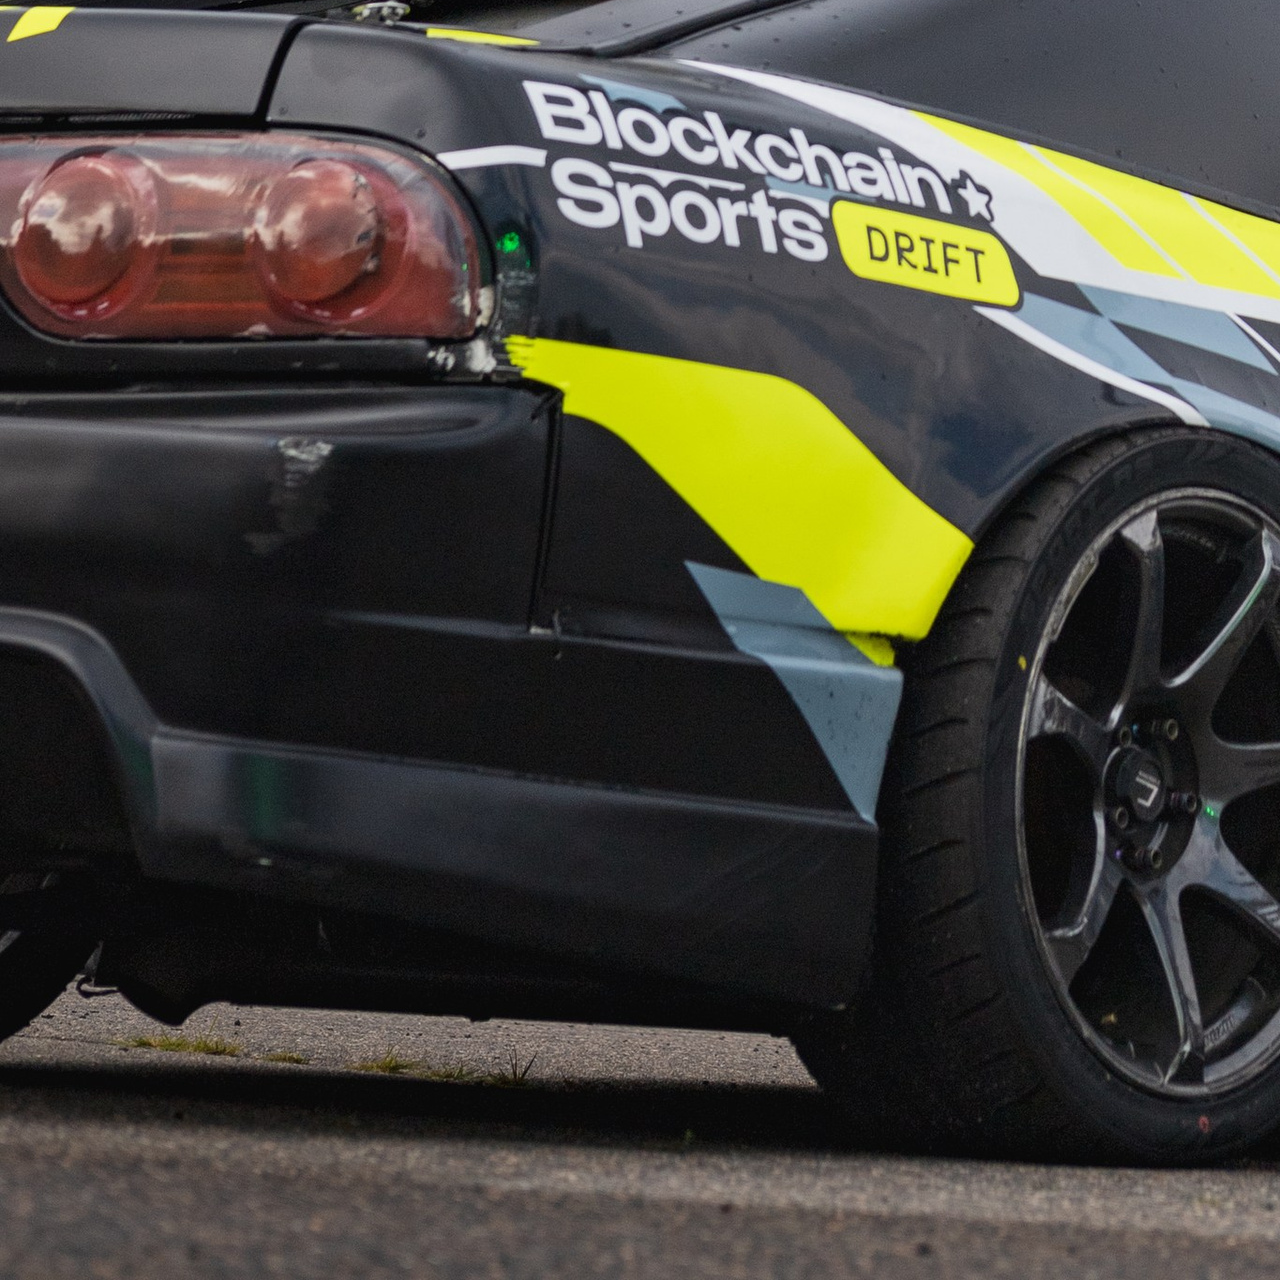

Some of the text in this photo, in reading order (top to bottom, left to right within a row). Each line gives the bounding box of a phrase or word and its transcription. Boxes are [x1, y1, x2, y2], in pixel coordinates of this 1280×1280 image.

[522, 80, 953, 214] Blockchain
[550, 157, 829, 262] Sports
[866, 225, 987, 283] DRIFT
